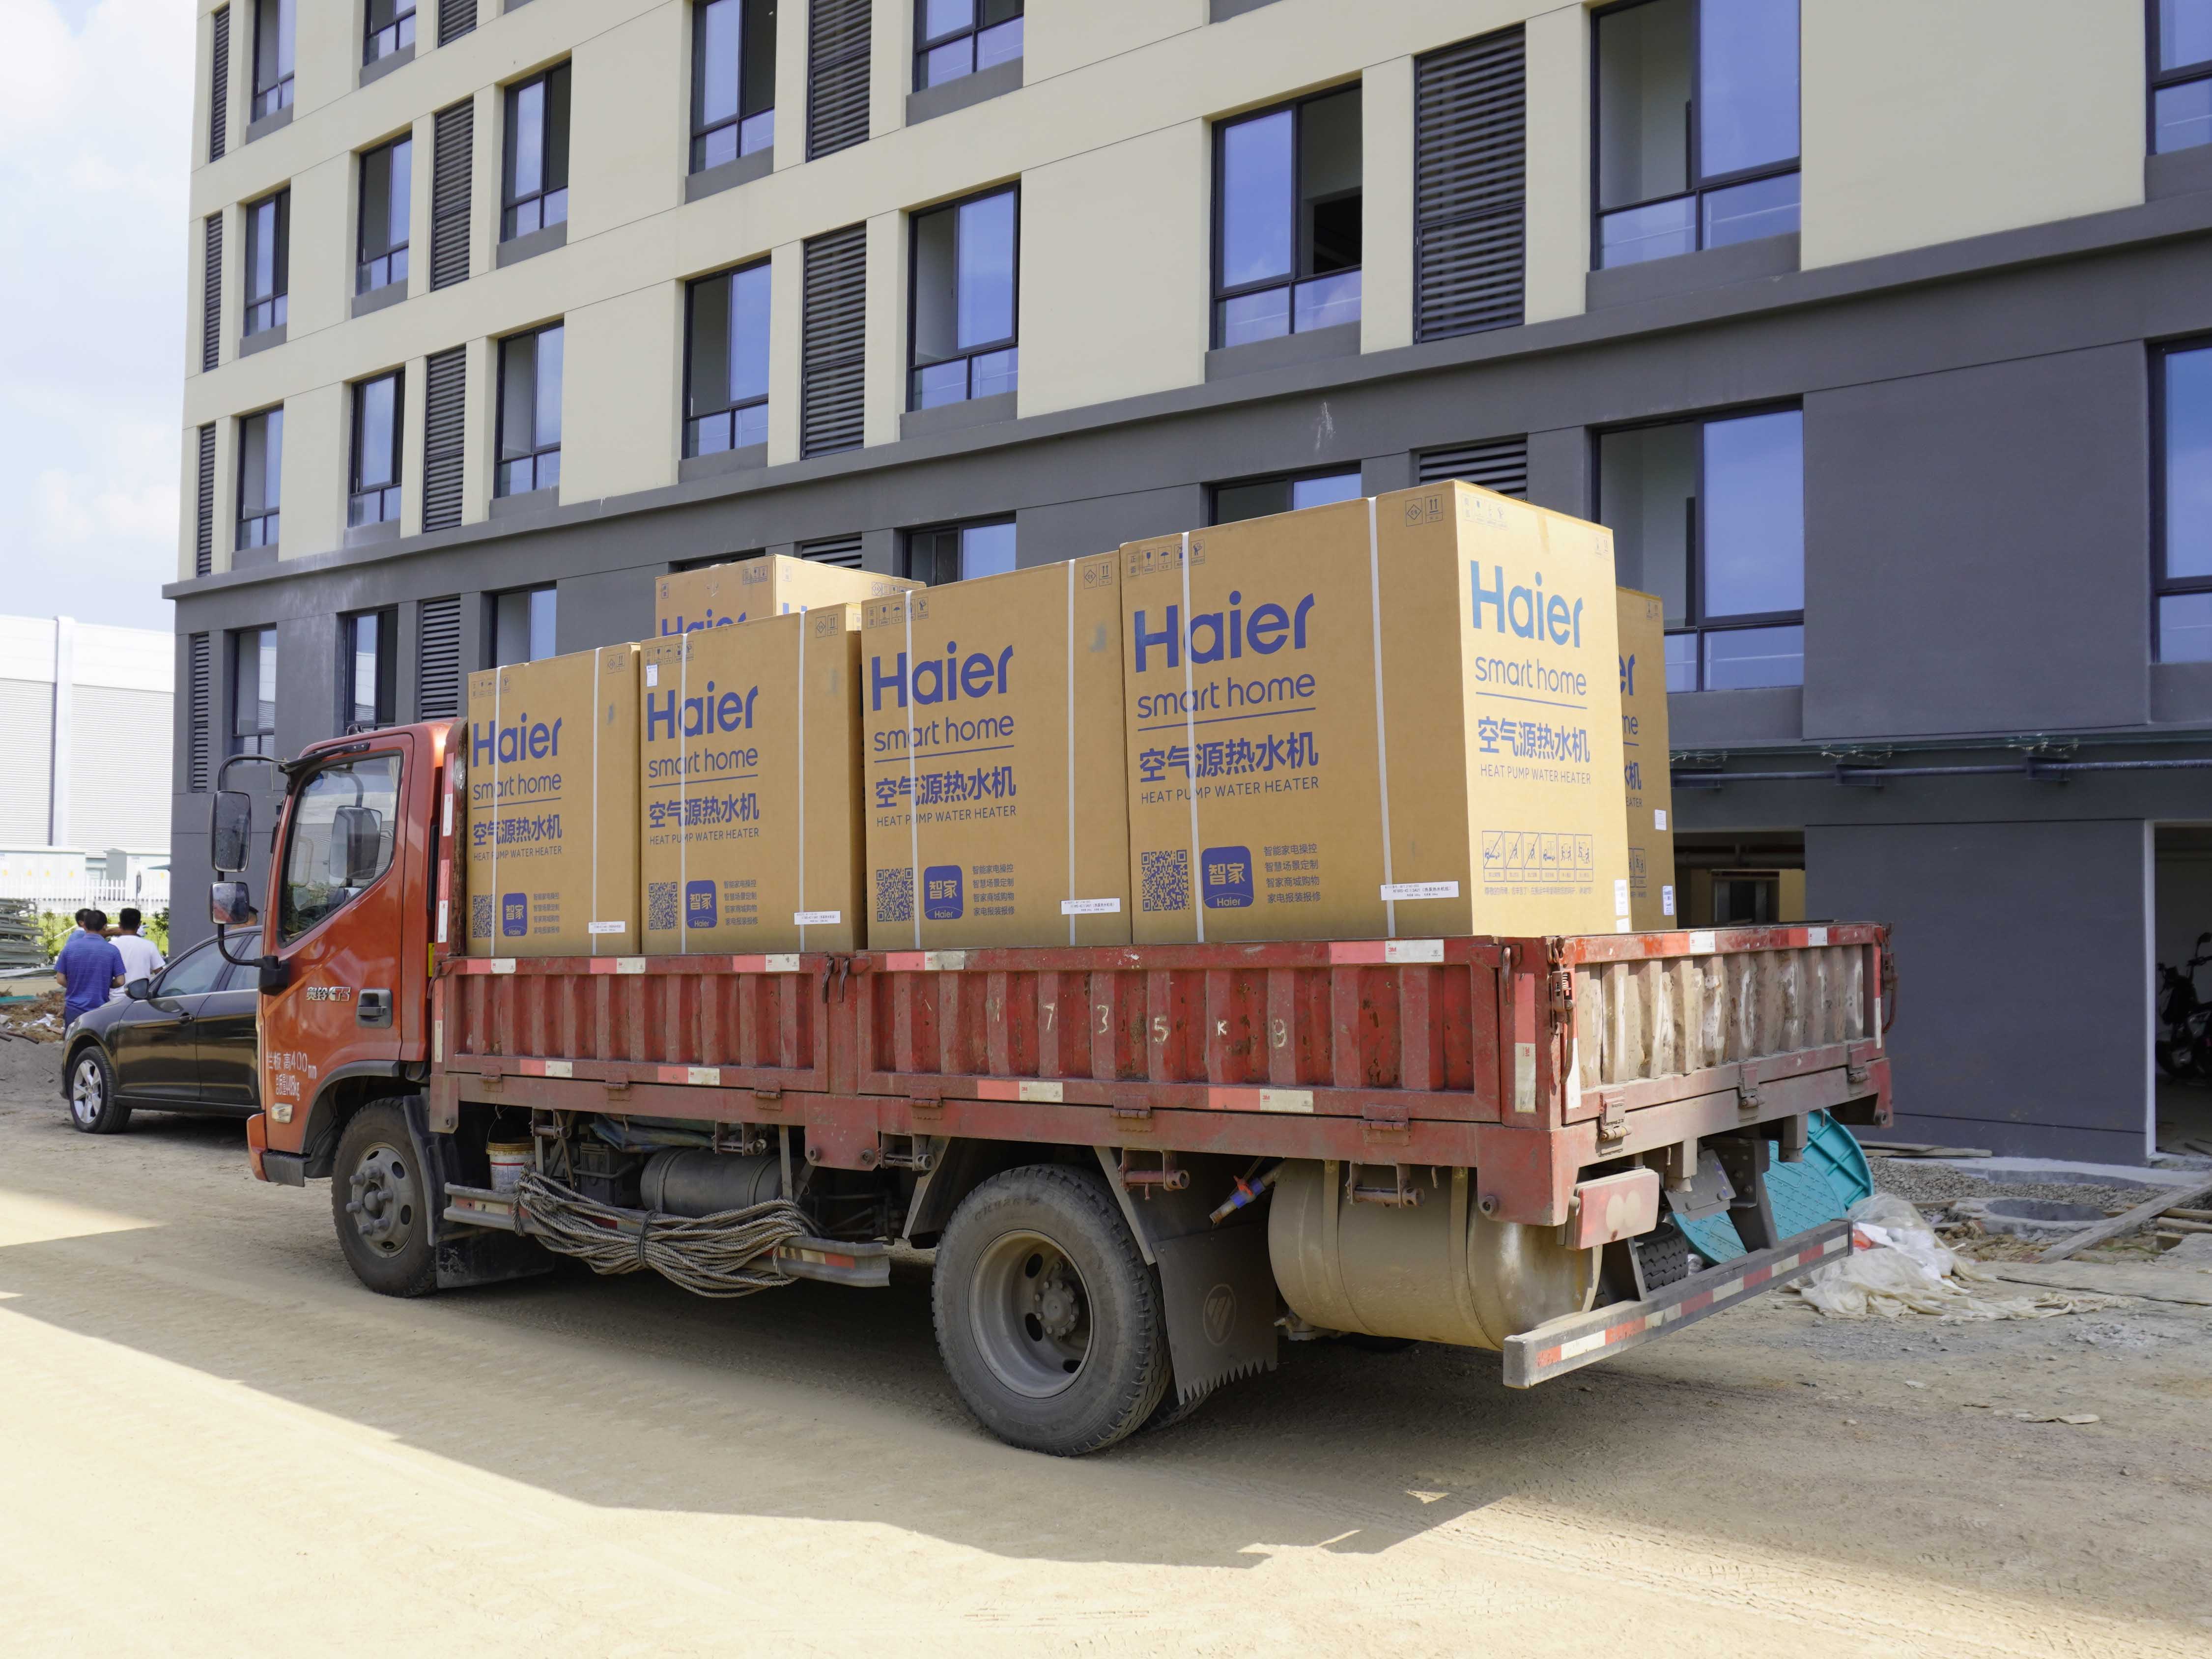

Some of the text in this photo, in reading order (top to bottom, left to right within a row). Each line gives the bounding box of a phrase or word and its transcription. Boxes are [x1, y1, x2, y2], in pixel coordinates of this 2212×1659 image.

[1470, 561, 1583, 648] Haier
[1134, 591, 1315, 673] Haier
[872, 641, 1014, 711] Haier
[1475, 656, 1533, 687] smart
[1537, 664, 1587, 695] home
[1137, 674, 1316, 718] smart home
[647, 681, 758, 742] Haier
[473, 712, 562, 767] Haier
[874, 715, 1014, 752] smart home
[1477, 716, 1590, 763] 空气源热水机
[649, 747, 758, 778] smart home
[1139, 732, 1319, 783] 空气源热水机
[473, 773, 562, 801] smart home
[876, 766, 1016, 808] 空气源热水机
[1480, 764, 1590, 785] HEAT PUMP WATER HEATER
[1141, 776, 1319, 804] HEAT PUMP WATER HEATER
[650, 792, 759, 828] 空气源热水机
[877, 815, 902, 827] HEAT
[936, 809, 971, 822] WATER
[975, 805, 1016, 818] HEATER
[473, 814, 562, 846] 空气源热水机
[650, 835, 670, 845] HEAT
[696, 830, 723, 841] WATER
[726, 828, 759, 839] HEATER
[474, 852, 490, 861] HEAT
[510, 848, 533, 858] WATER
[535, 846, 562, 856] HEATER
[1264, 843, 1317, 856] 智能家电操控
[1209, 863, 1245, 885] 智家
[1265, 858, 1319, 872] 智慧场景定制
[929, 880, 957, 900] 智家
[1266, 875, 1320, 888] 智家商城购物
[689, 893, 712, 910] 智家
[1217, 897, 1241, 907] Haier
[1267, 891, 1321, 904] 家电报装报修
[506, 904, 524, 920] 智家
[935, 910, 953, 918] Haier
[307, 987, 328, 1001] 奥铃
